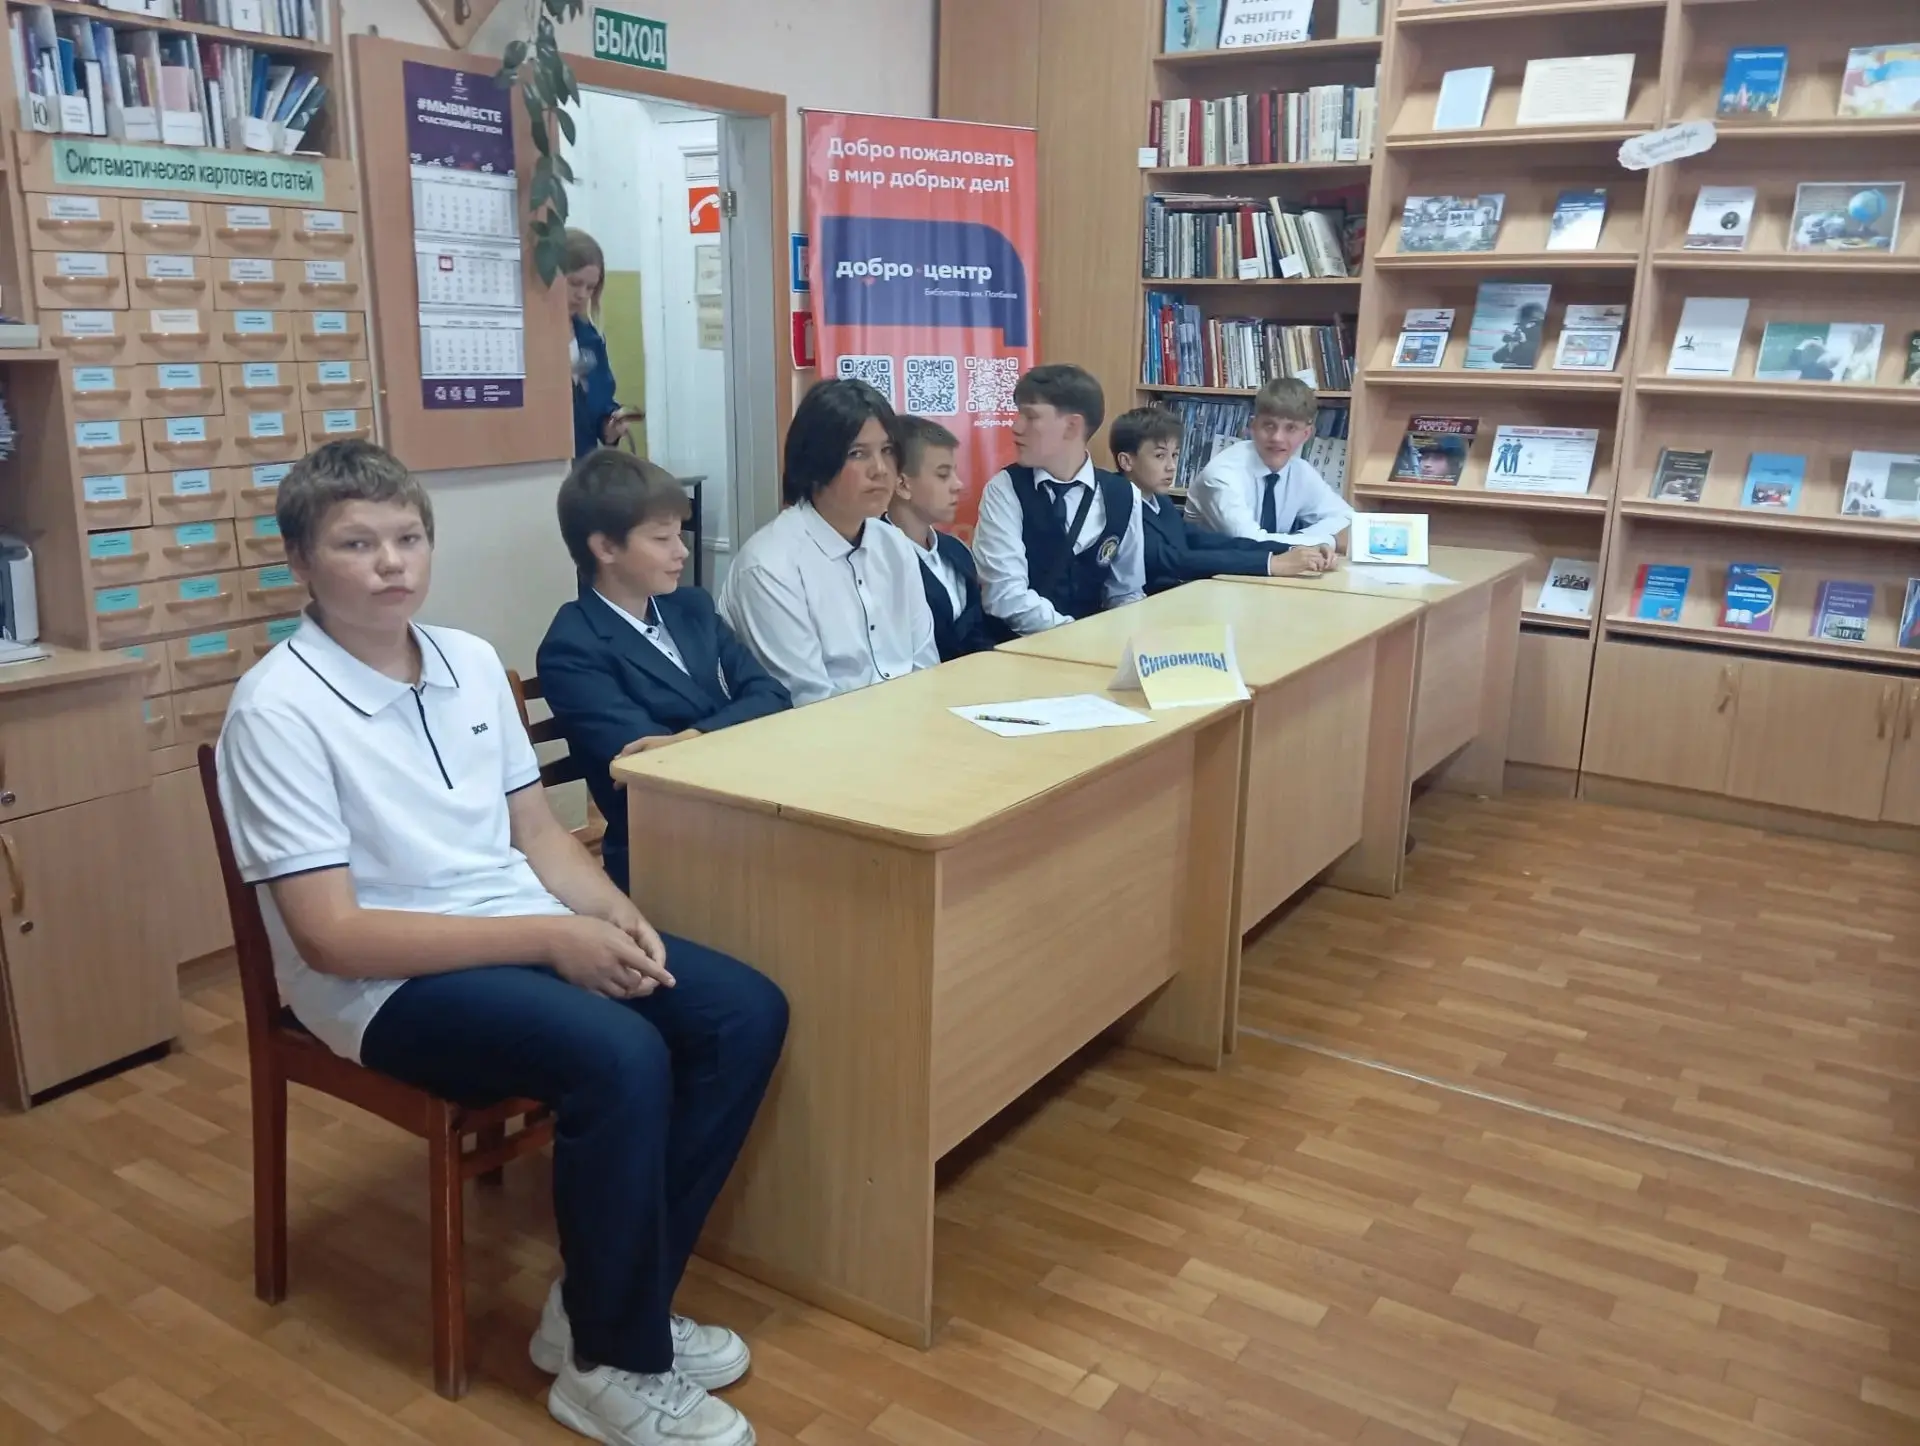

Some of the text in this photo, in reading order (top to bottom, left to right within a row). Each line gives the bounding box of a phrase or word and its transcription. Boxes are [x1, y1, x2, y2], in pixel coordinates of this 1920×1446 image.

[1234, 9, 1293, 24] книги
[595, 15, 665, 64] ВЫХОД
[1225, 28, 1301, 44] о войне
[33, 104, 48, 126] Ю
[417, 98, 502, 123] #МЫВМЕСТЕ
[827, 137, 1014, 167] Добро пожаловать
[66, 149, 314, 191] Систематическая картотека статей
[828, 168, 1010, 194] в мир добрых дел!
[836, 257, 993, 284] добро центр
[1139, 652, 1228, 678] Синонимы
